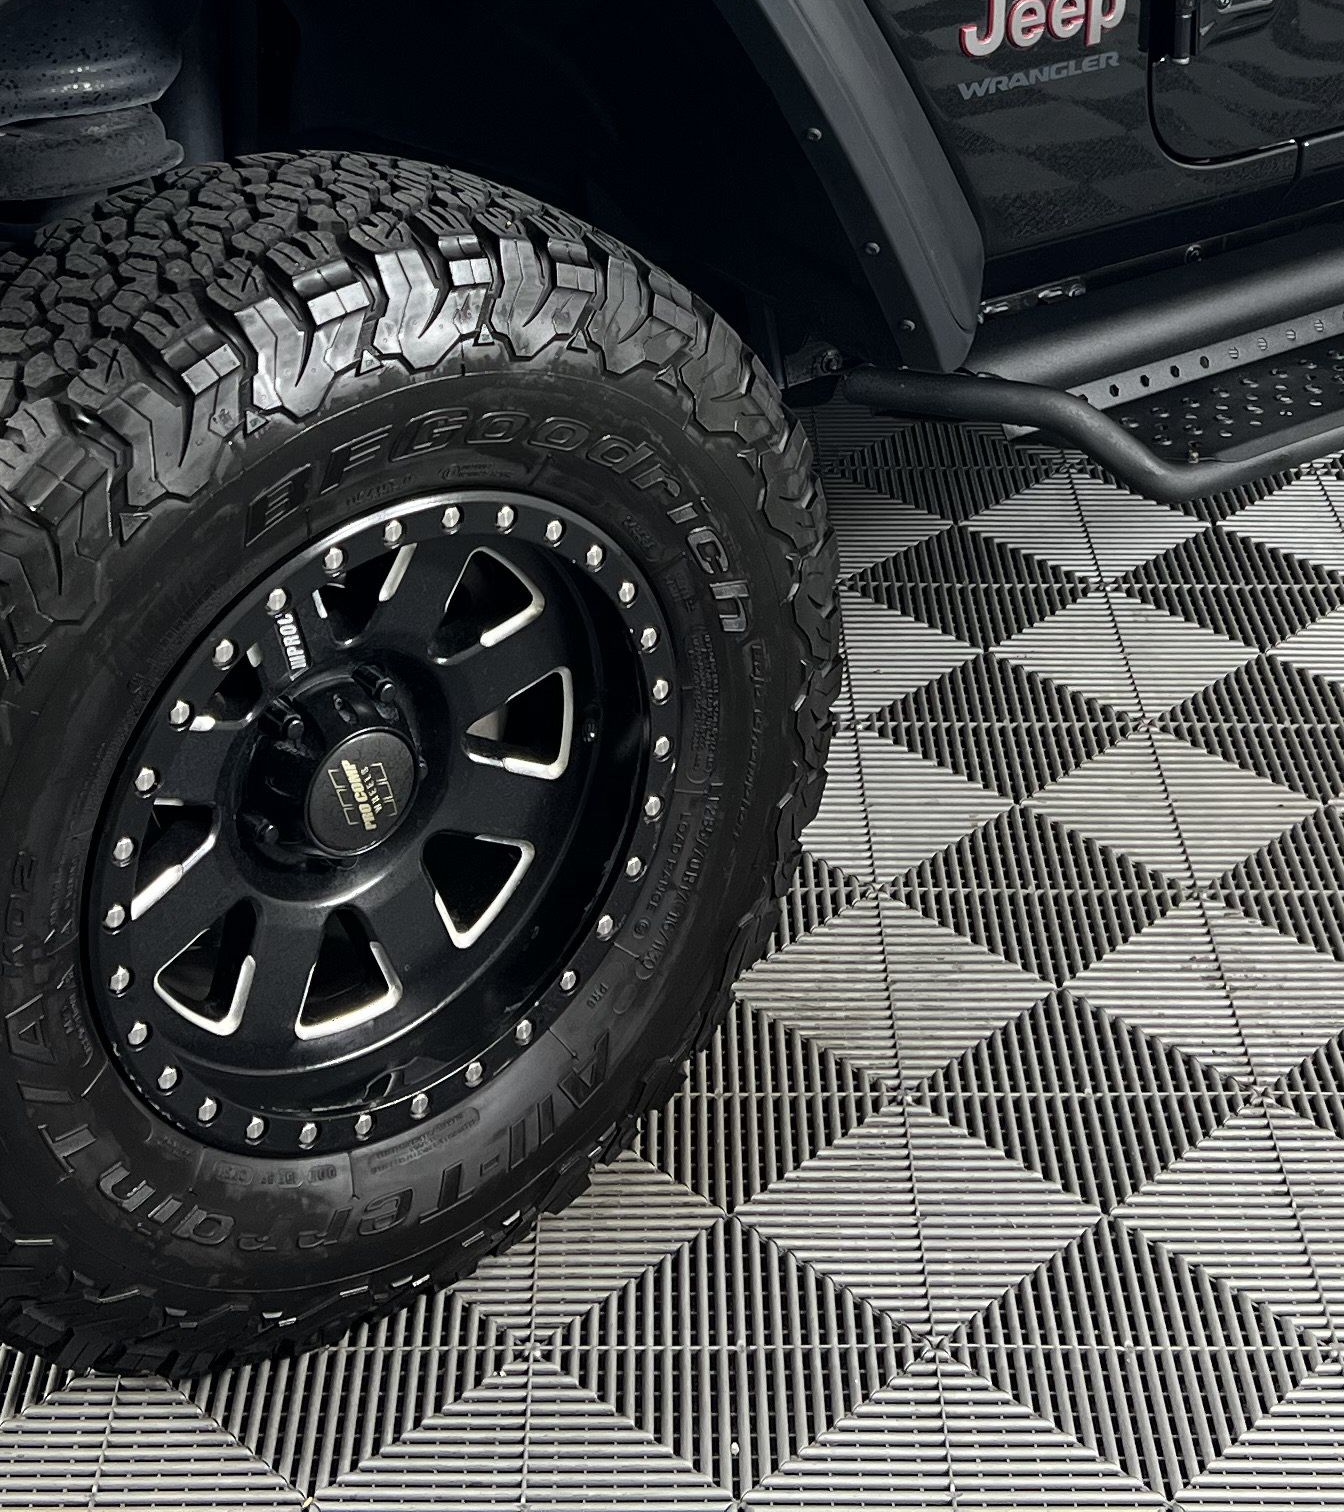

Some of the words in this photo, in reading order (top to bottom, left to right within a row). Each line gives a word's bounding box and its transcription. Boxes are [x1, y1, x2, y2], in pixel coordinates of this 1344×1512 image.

[958, 51, 1120, 100] WRANGLER
[245, 407, 748, 635] BFGoodrich
[340, 759, 369, 804] COMP
[360, 765, 383, 815] WHEELS
[357, 803, 378, 832] PRO
[668, 810, 693, 855] LOAD
[98, 1033, 611, 1254] All-Terrain
